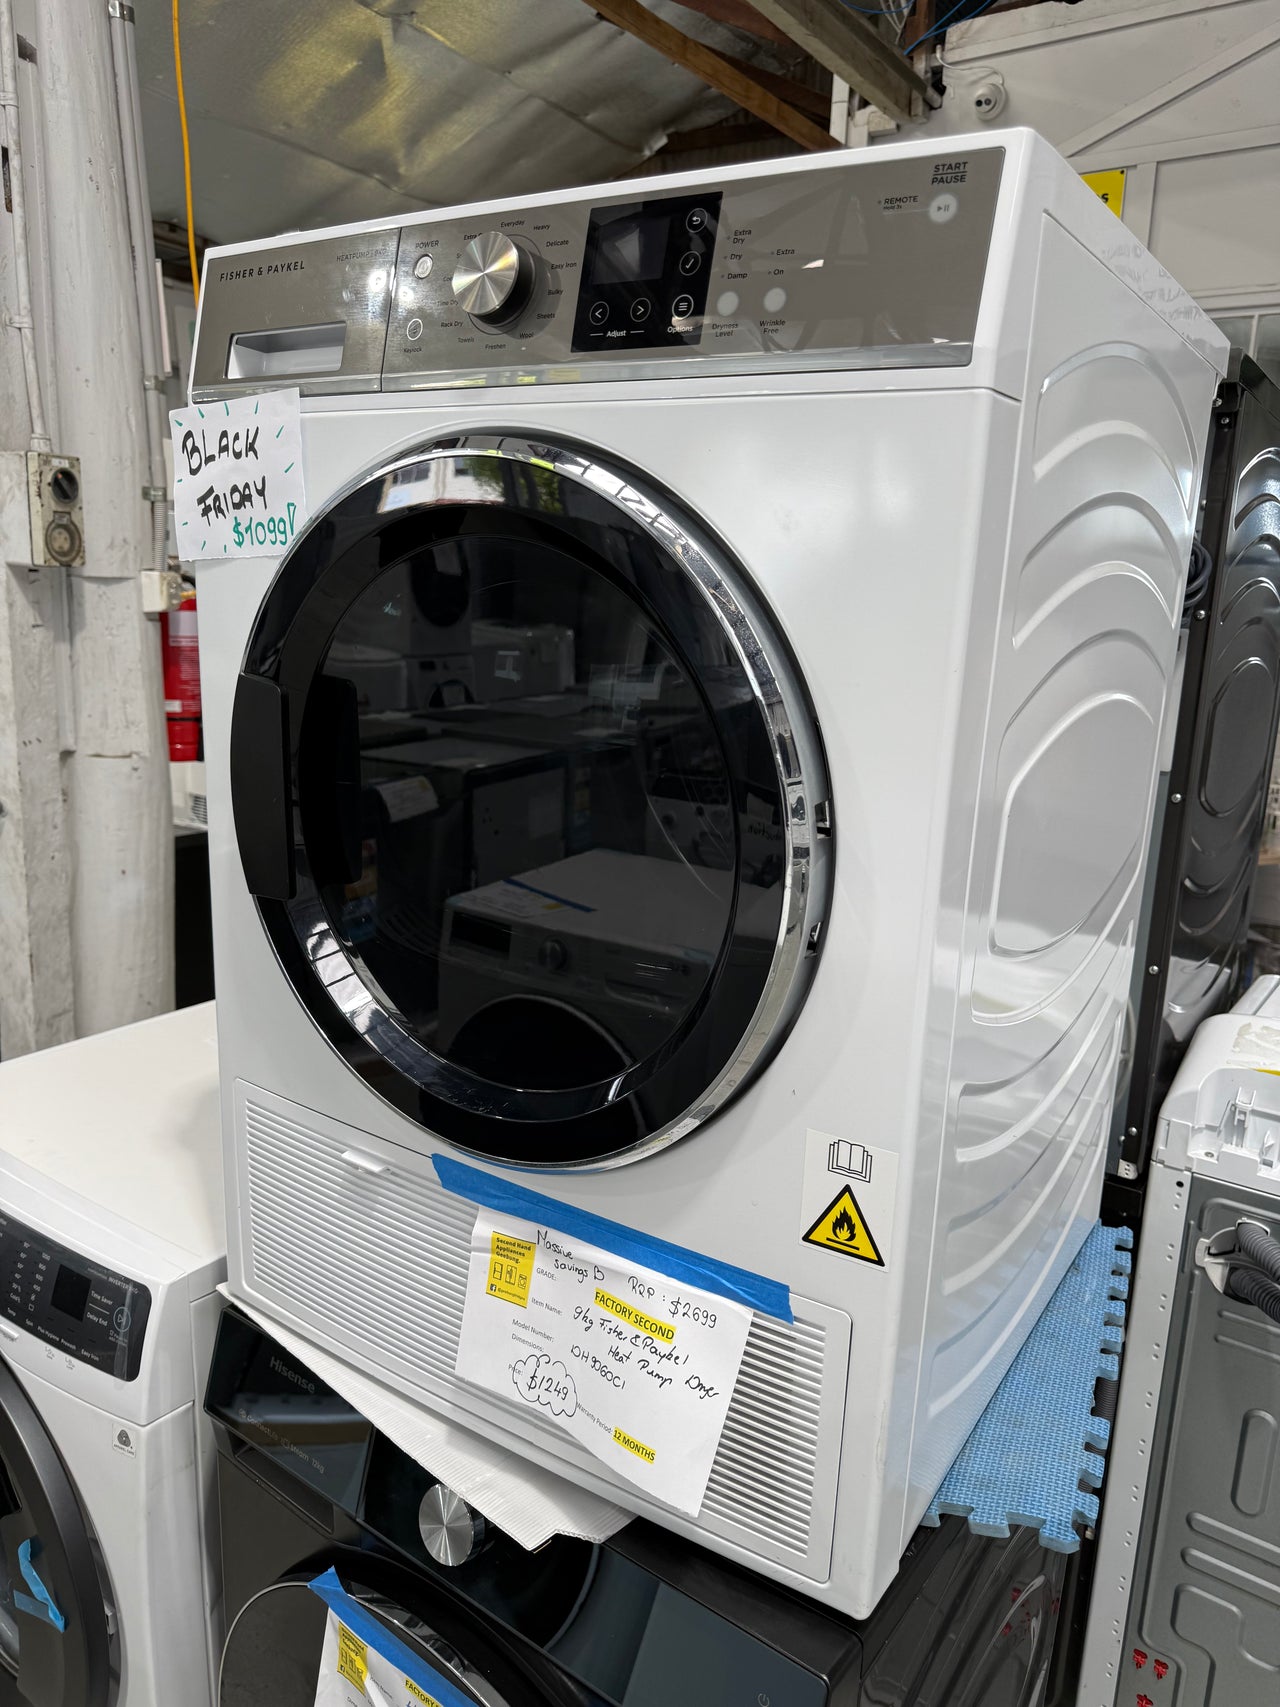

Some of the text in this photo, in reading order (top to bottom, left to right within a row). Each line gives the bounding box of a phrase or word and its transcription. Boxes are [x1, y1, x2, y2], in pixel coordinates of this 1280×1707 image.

[934, 161, 968, 173] START
[931, 174, 967, 185] PAUSE
[884, 195, 918, 205] REMOTE
[500, 219, 525, 228] Everyday
[415, 240, 439, 249] POWER
[546, 239, 569, 247] Delicate
[733, 236, 745, 245] Dry
[730, 253, 743, 261] Dry
[776, 248, 795, 256] Extra
[565, 261, 577, 269] Iron
[220, 260, 305, 282] FISHER & PAYKEL
[727, 272, 748, 281] Damp
[547, 288, 563, 297] Bulky
[536, 312, 555, 320] Sheets
[453, 320, 463, 328] Dry
[712, 323, 739, 331] Dryness
[759, 319, 786, 328] Wrinkle
[606, 330, 627, 338] Adjust
[667, 325, 693, 334] Options
[763, 327, 779, 335] Free
[181, 426, 259, 476] BLACK
[196, 475, 267, 527] FRIDAY
[496, 1237, 532, 1251] Second Hand
[536, 1229, 574, 1260] Massive
[495, 1244, 526, 1257] Appliances
[536, 1267, 557, 1281] GRADE:
[91, 1290, 101, 1301] Time
[531, 1297, 563, 1315] Item Name:
[594, 1290, 675, 1341] FACTORY SECOND
[668, 1296, 718, 1329] $2699
[86, 1311, 108, 1327] Delay End
[512, 1318, 554, 1342] Model Number:
[511, 1333, 544, 1353] Dimensions:
[608, 1345, 631, 1364] Heat
[269, 1356, 315, 1394] Hisense
[527, 1366, 569, 1401] $1249
[613, 1429, 656, 1462] 12 MONTHS
[404, 1679, 435, 1707] FACTORY
